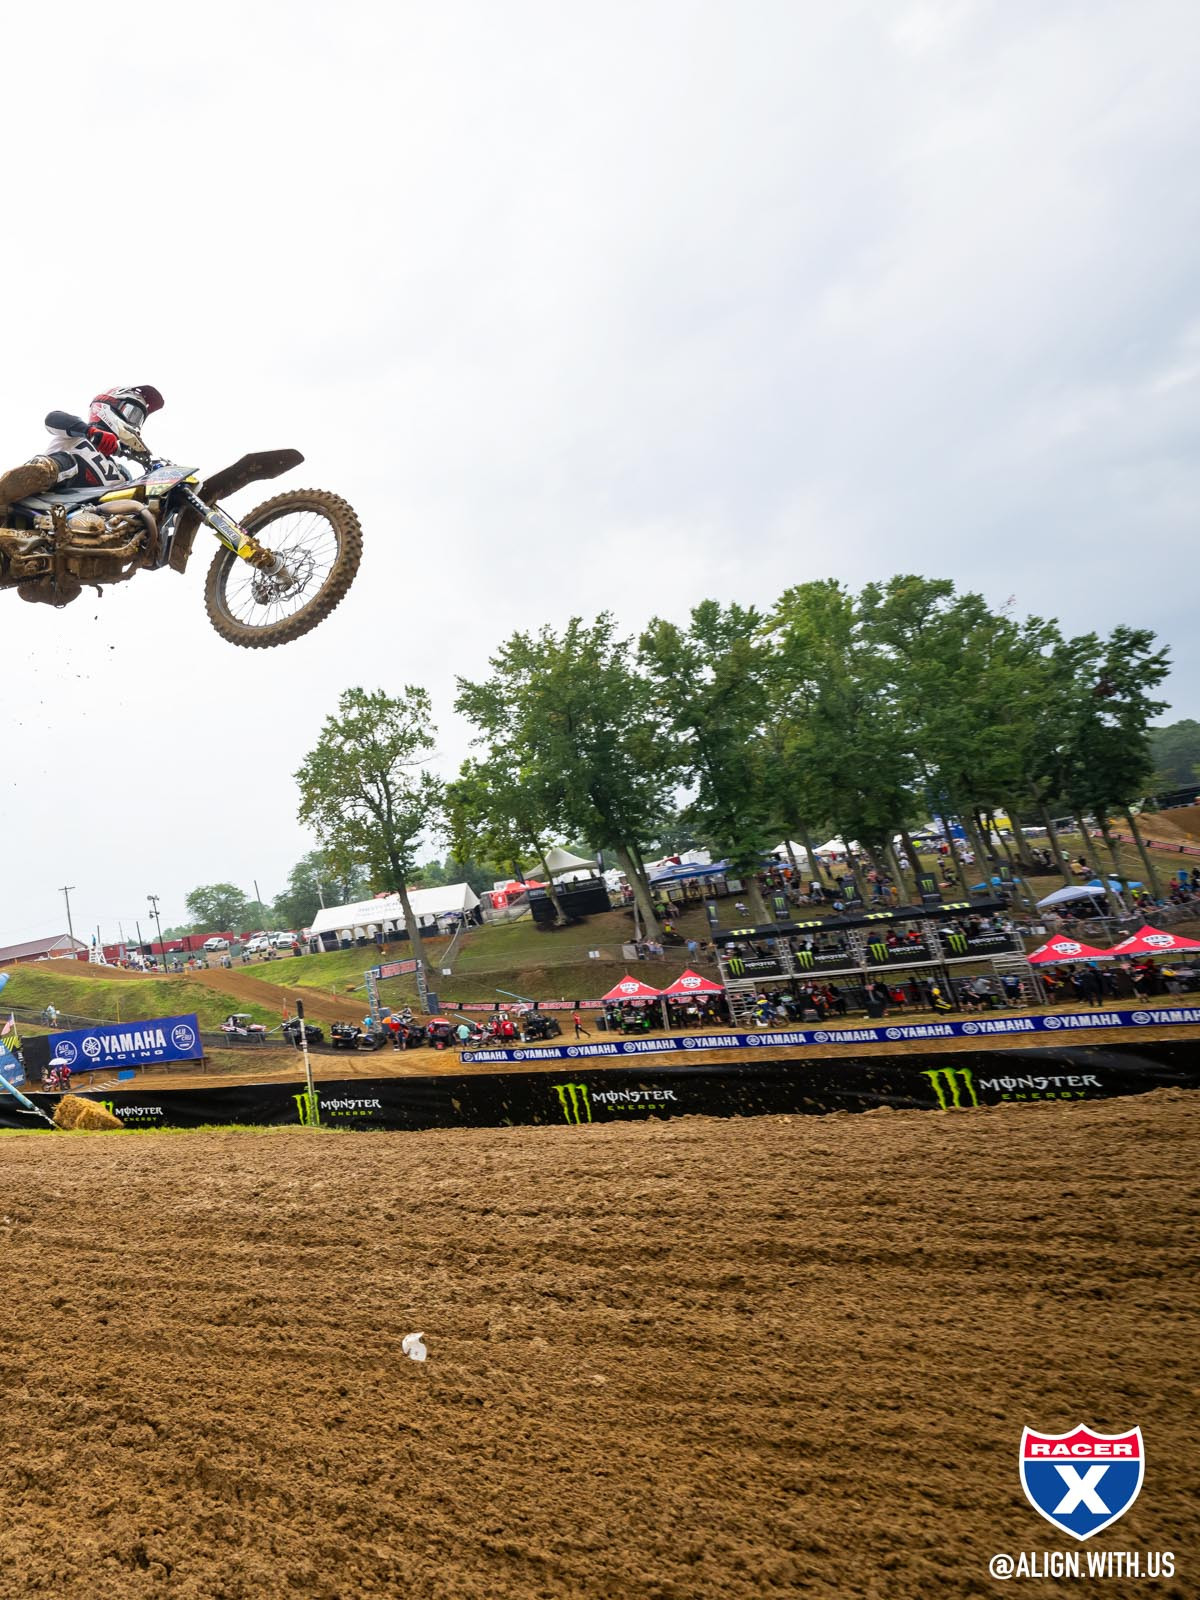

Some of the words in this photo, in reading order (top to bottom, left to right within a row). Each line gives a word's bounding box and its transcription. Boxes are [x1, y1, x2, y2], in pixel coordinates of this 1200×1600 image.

[1059, 1013, 1122, 1027] YAMAHA
[1150, 1010, 1200, 1023] YAMAH
[898, 1024, 954, 1037] YAMAHA
[977, 1018, 1035, 1032] YAMAHA
[100, 1029, 167, 1054] YAMAHA
[759, 1032, 806, 1044] YAMAHA
[827, 1029, 879, 1042] YAMAHA
[635, 1040, 677, 1052] YAMAHA
[694, 1036, 740, 1048] YAMAHA
[523, 1048, 561, 1059] YAMAHA
[577, 1044, 618, 1056] YAMAHA
[91, 1050, 164, 1063] RACING
[472, 1051, 508, 1062] YAMAHA
[979, 1074, 1103, 1091] MONSTER
[592, 1089, 678, 1104] MONSTER
[1001, 1091, 1087, 1100] ENERGY
[320, 1098, 381, 1110] MONSTER
[607, 1103, 666, 1111] ENERGY
[115, 1106, 164, 1117] MONSTER
